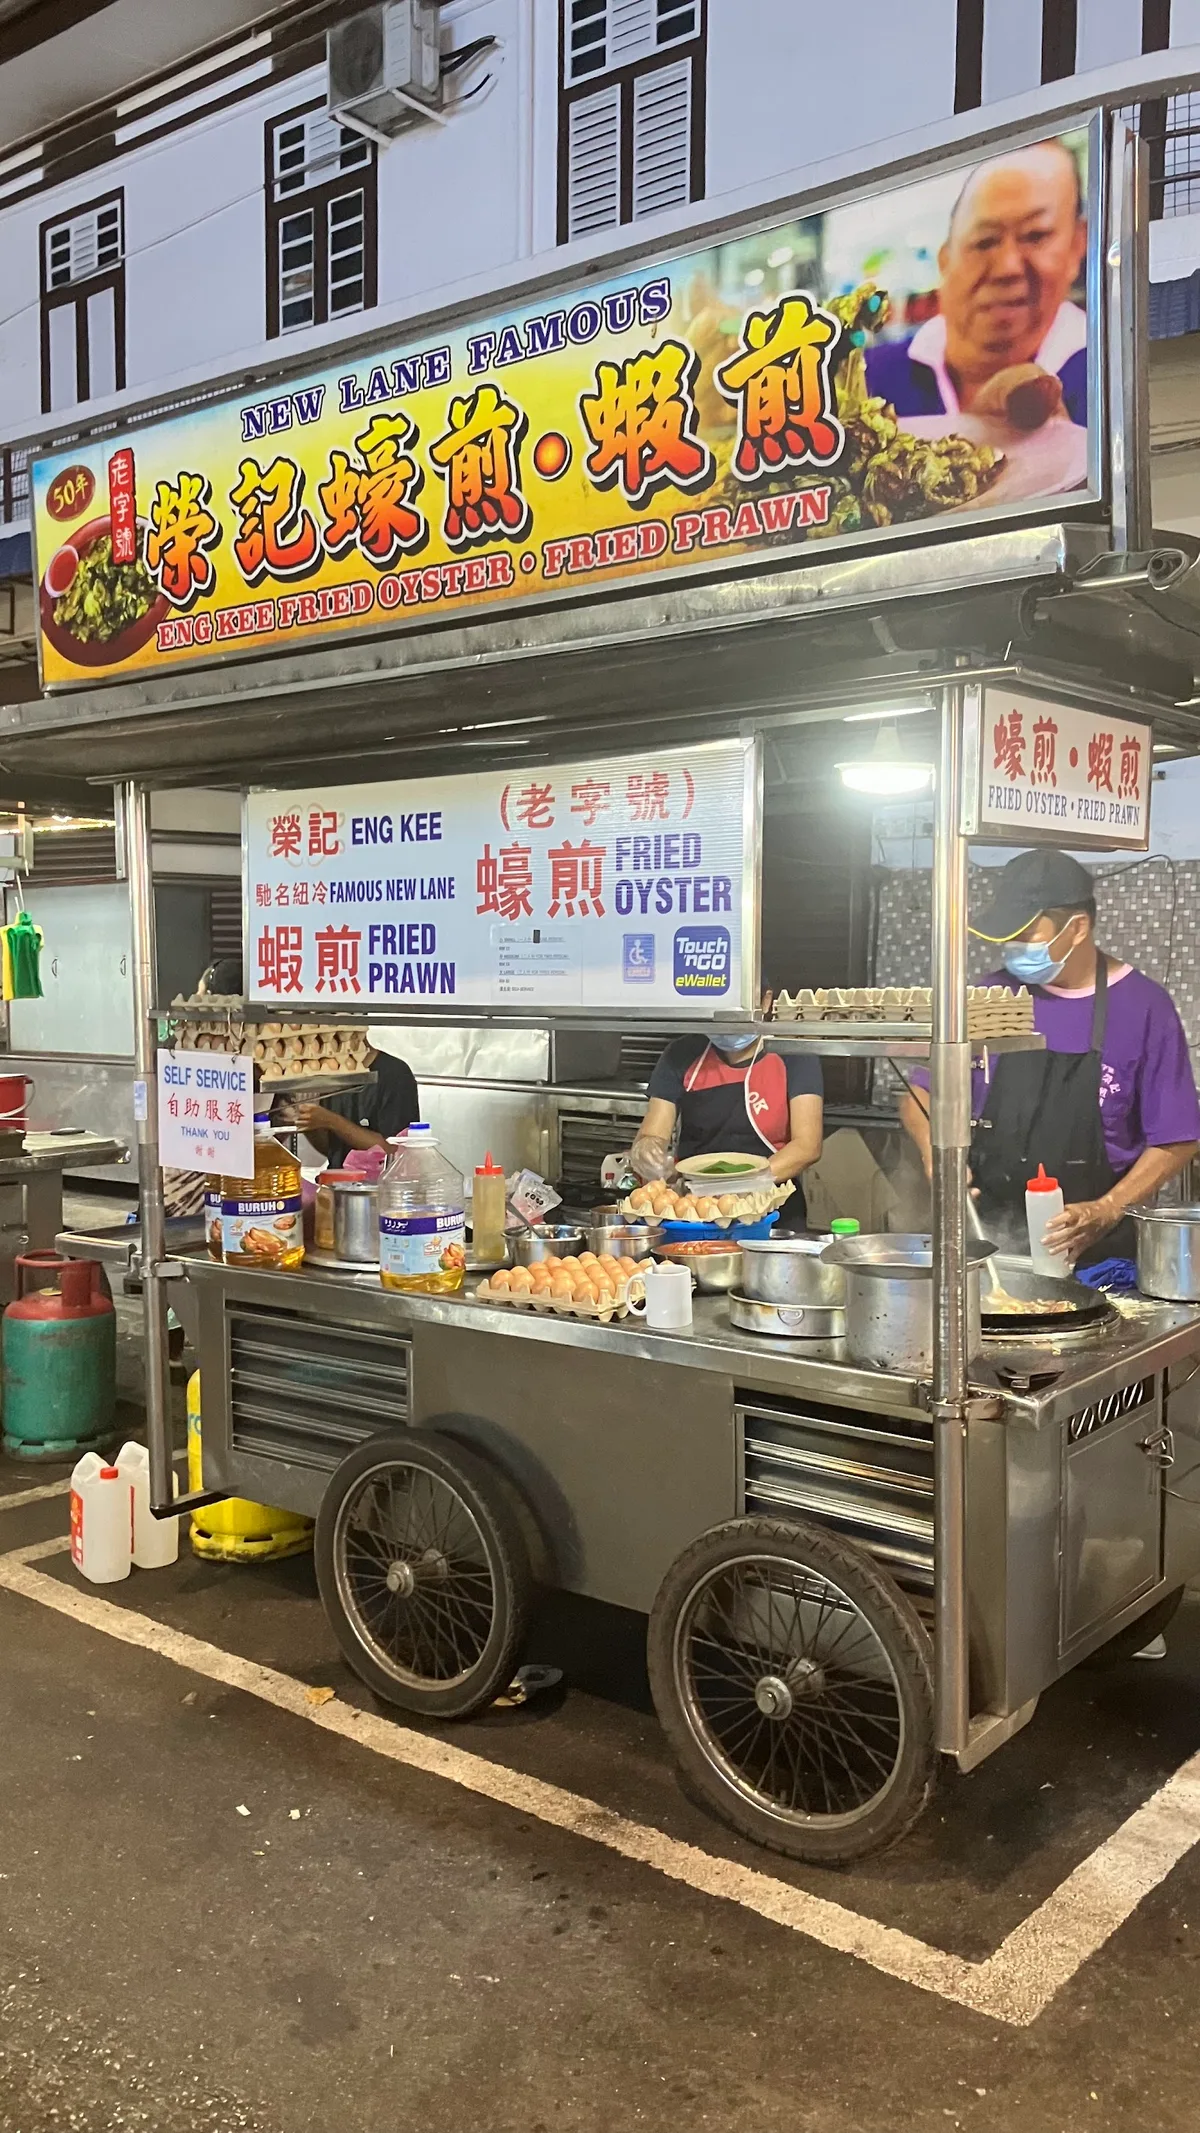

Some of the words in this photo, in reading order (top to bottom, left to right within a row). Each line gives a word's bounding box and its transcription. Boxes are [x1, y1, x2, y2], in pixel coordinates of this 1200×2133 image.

[242, 385, 325, 440] NEW
[340, 347, 450, 412] LANE
[469, 278, 671, 371] FAMOUS
[53, 473, 88, 514] 50年
[111, 457, 133, 557] 老字號
[157, 617, 212, 650] ENG
[217, 603, 274, 638] KEE
[279, 582, 373, 624] FRIED
[379, 555, 513, 605] OYSTER
[543, 524, 667, 577] FRIED
[675, 487, 832, 549] PRAWN
[993, 708, 1058, 788] 蠔煎
[1088, 732, 1141, 801] 蝦煎
[988, 784, 1022, 811] FRIED
[1026, 791, 1067, 818] OYSTER
[1077, 798, 1106, 822] FRIED
[1109, 802, 1141, 827] PRAWN
[272, 811, 339, 858] 榮記
[351, 815, 393, 845] ENG
[400, 811, 442, 842] KEE
[615, 833, 702, 871] FRIED
[330, 880, 382, 903] FAMOUS
[386, 878, 417, 901] NEW
[421, 877, 456, 900] LANE
[476, 838, 606, 921] 蠔煎
[615, 875, 732, 916] OYSTER
[258, 923, 362, 995] 蝦煎
[368, 923, 436, 955] FRIED
[676, 936, 728, 954] Touch
[368, 961, 456, 994] PRAWN
[675, 973, 727, 987] eWallet
[164, 1065, 192, 1085] SELF
[196, 1068, 246, 1092] SERVICE
[167, 1092, 245, 1125] 自助服務
[181, 1125, 208, 1138] THANK
[212, 1130, 230, 1141] YOU
